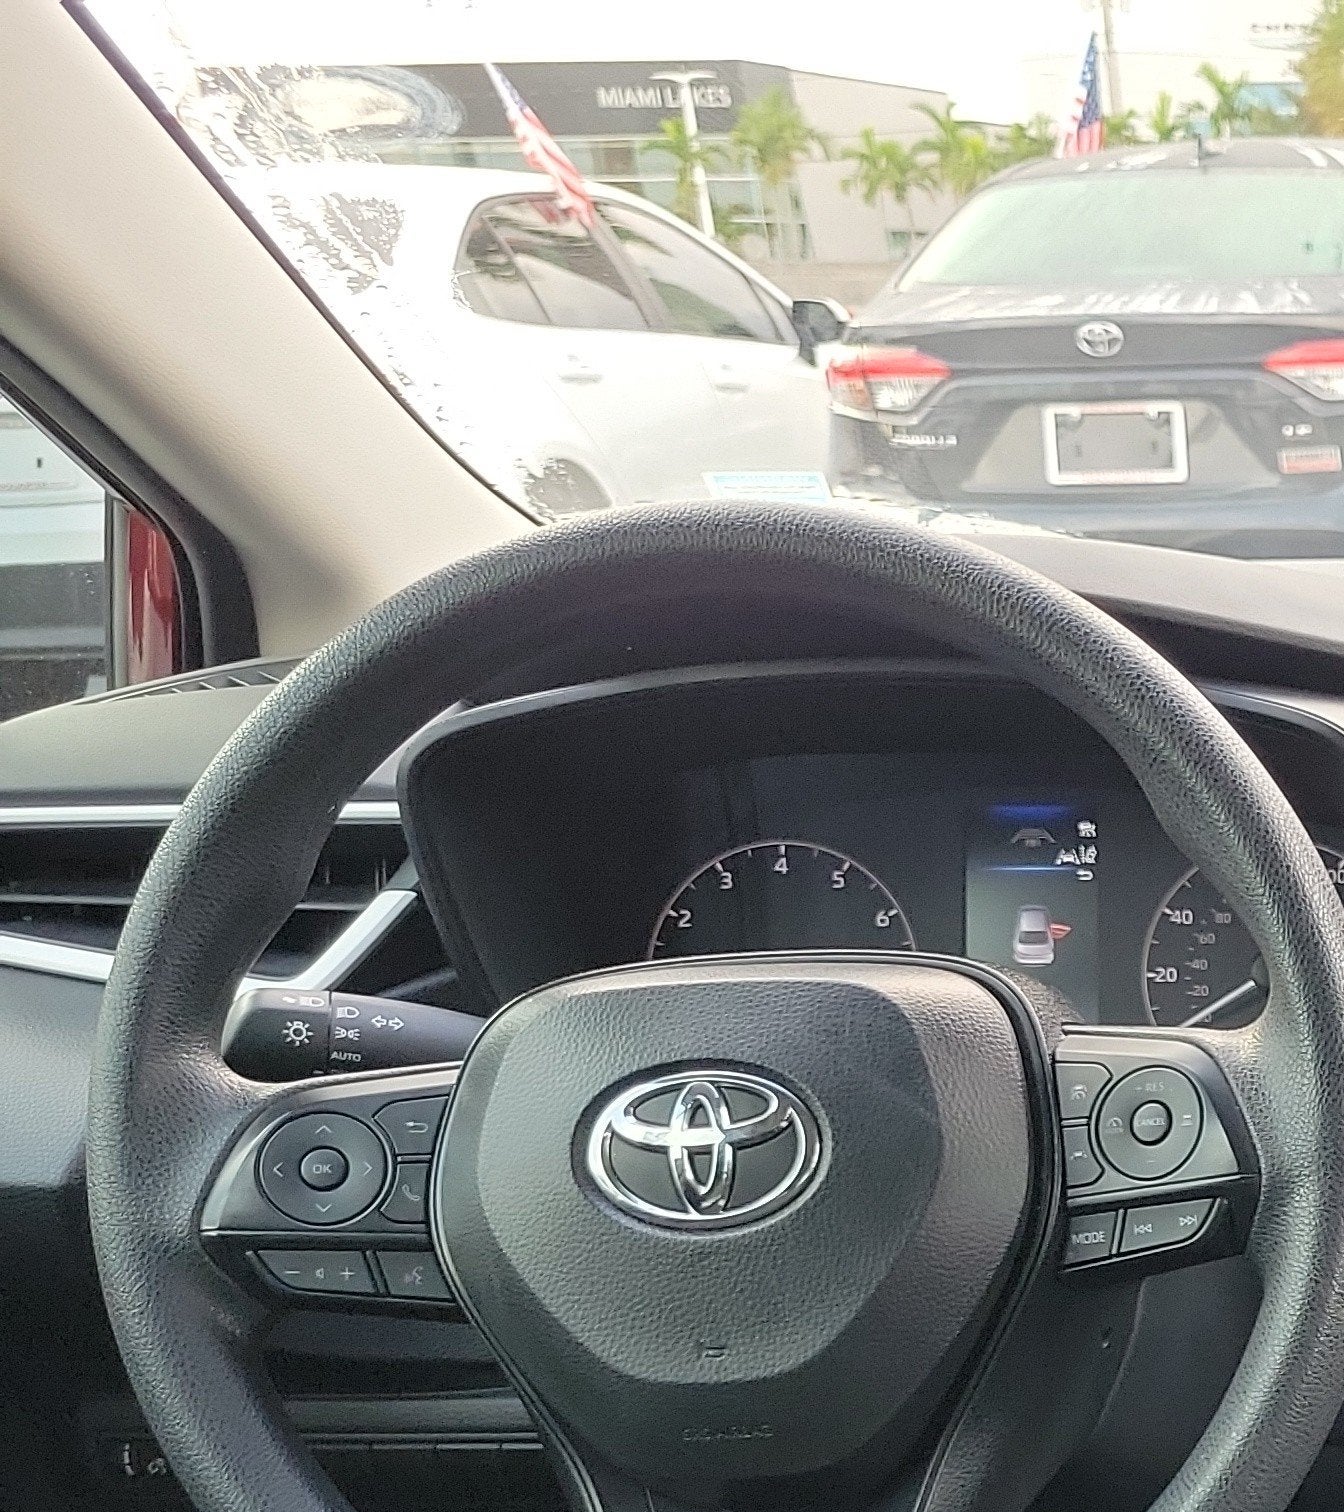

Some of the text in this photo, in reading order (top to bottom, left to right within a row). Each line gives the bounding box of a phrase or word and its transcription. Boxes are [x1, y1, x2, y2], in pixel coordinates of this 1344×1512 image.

[598, 86, 732, 108] MIAMI LKES
[773, 857, 789, 875] 4
[719, 872, 733, 890] 3
[831, 871, 845, 889] 5
[677, 909, 692, 928] 2
[875, 910, 890, 927] 6
[1170, 909, 1193, 925] 40
[1154, 966, 1178, 983] 20
[1193, 985, 1209, 996] 20
[330, 1050, 362, 1062] AUTO
[313, 1164, 332, 1174] OK
[1071, 1231, 1106, 1245] MODE
